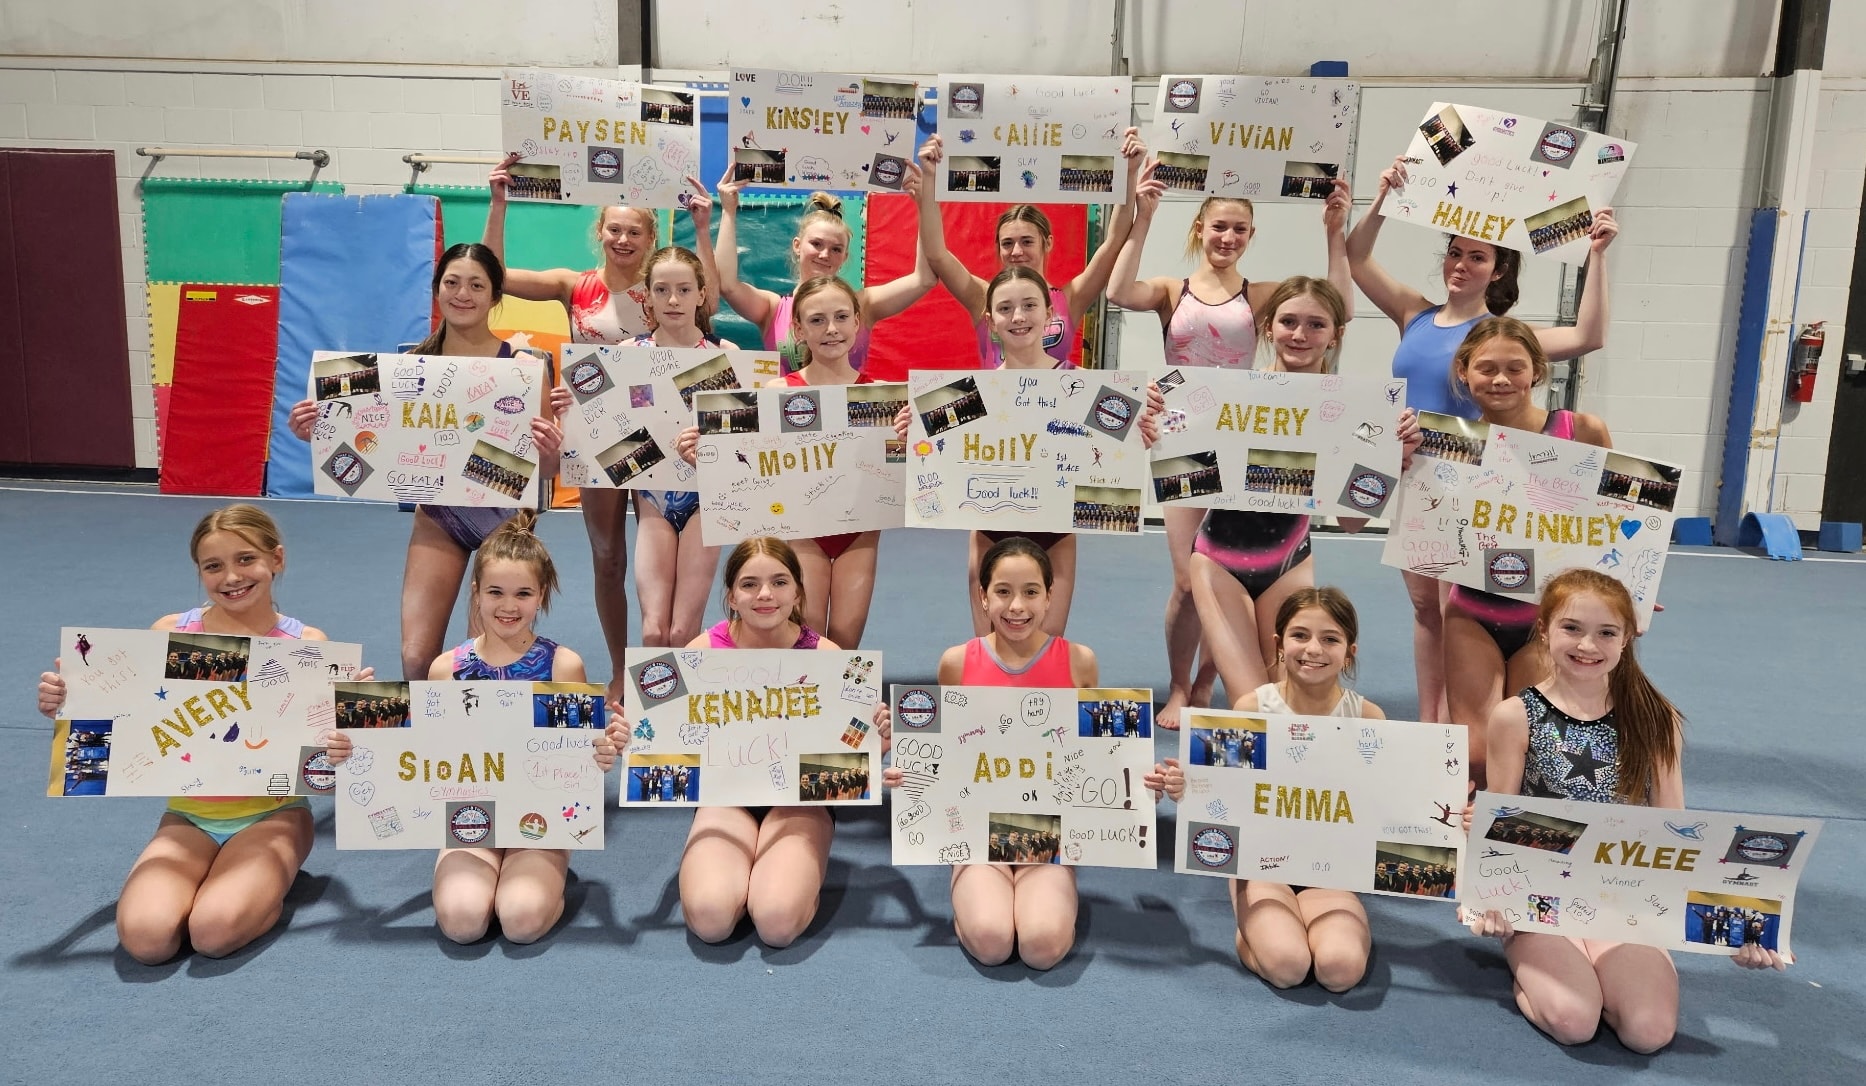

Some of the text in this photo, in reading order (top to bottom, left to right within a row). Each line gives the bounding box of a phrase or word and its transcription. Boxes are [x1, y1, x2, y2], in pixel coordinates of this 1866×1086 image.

[736, 73, 755, 82] LOVE
[543, 117, 646, 145] PAYSEN
[1017, 157, 1037, 166] SLAY
[1431, 201, 1516, 241] HAILEY
[394, 366, 424, 377] GOOD
[1015, 396, 1057, 408] Got this!
[361, 414, 385, 423] NICE
[402, 402, 459, 430] KAIA
[1216, 403, 1310, 436] AVERY
[387, 470, 444, 486] GO KAIA!
[966, 477, 1000, 500] Good
[1248, 495, 1275, 507] Good
[425, 687, 441, 698] You
[688, 685, 821, 725] KENADEE
[150, 680, 253, 758] AVERY
[526, 735, 563, 752] Good
[897, 738, 943, 760] GOOD
[1022, 791, 1037, 802] OK
[1081, 768, 1132, 810] GO!
[1253, 782, 1355, 824] EMMA
[909, 832, 924, 845] GO
[1593, 840, 1701, 872] KYLEE
[1479, 860, 1528, 878] Good
[1601, 874, 1645, 887] Winner
[1645, 895, 1668, 916] Slay
